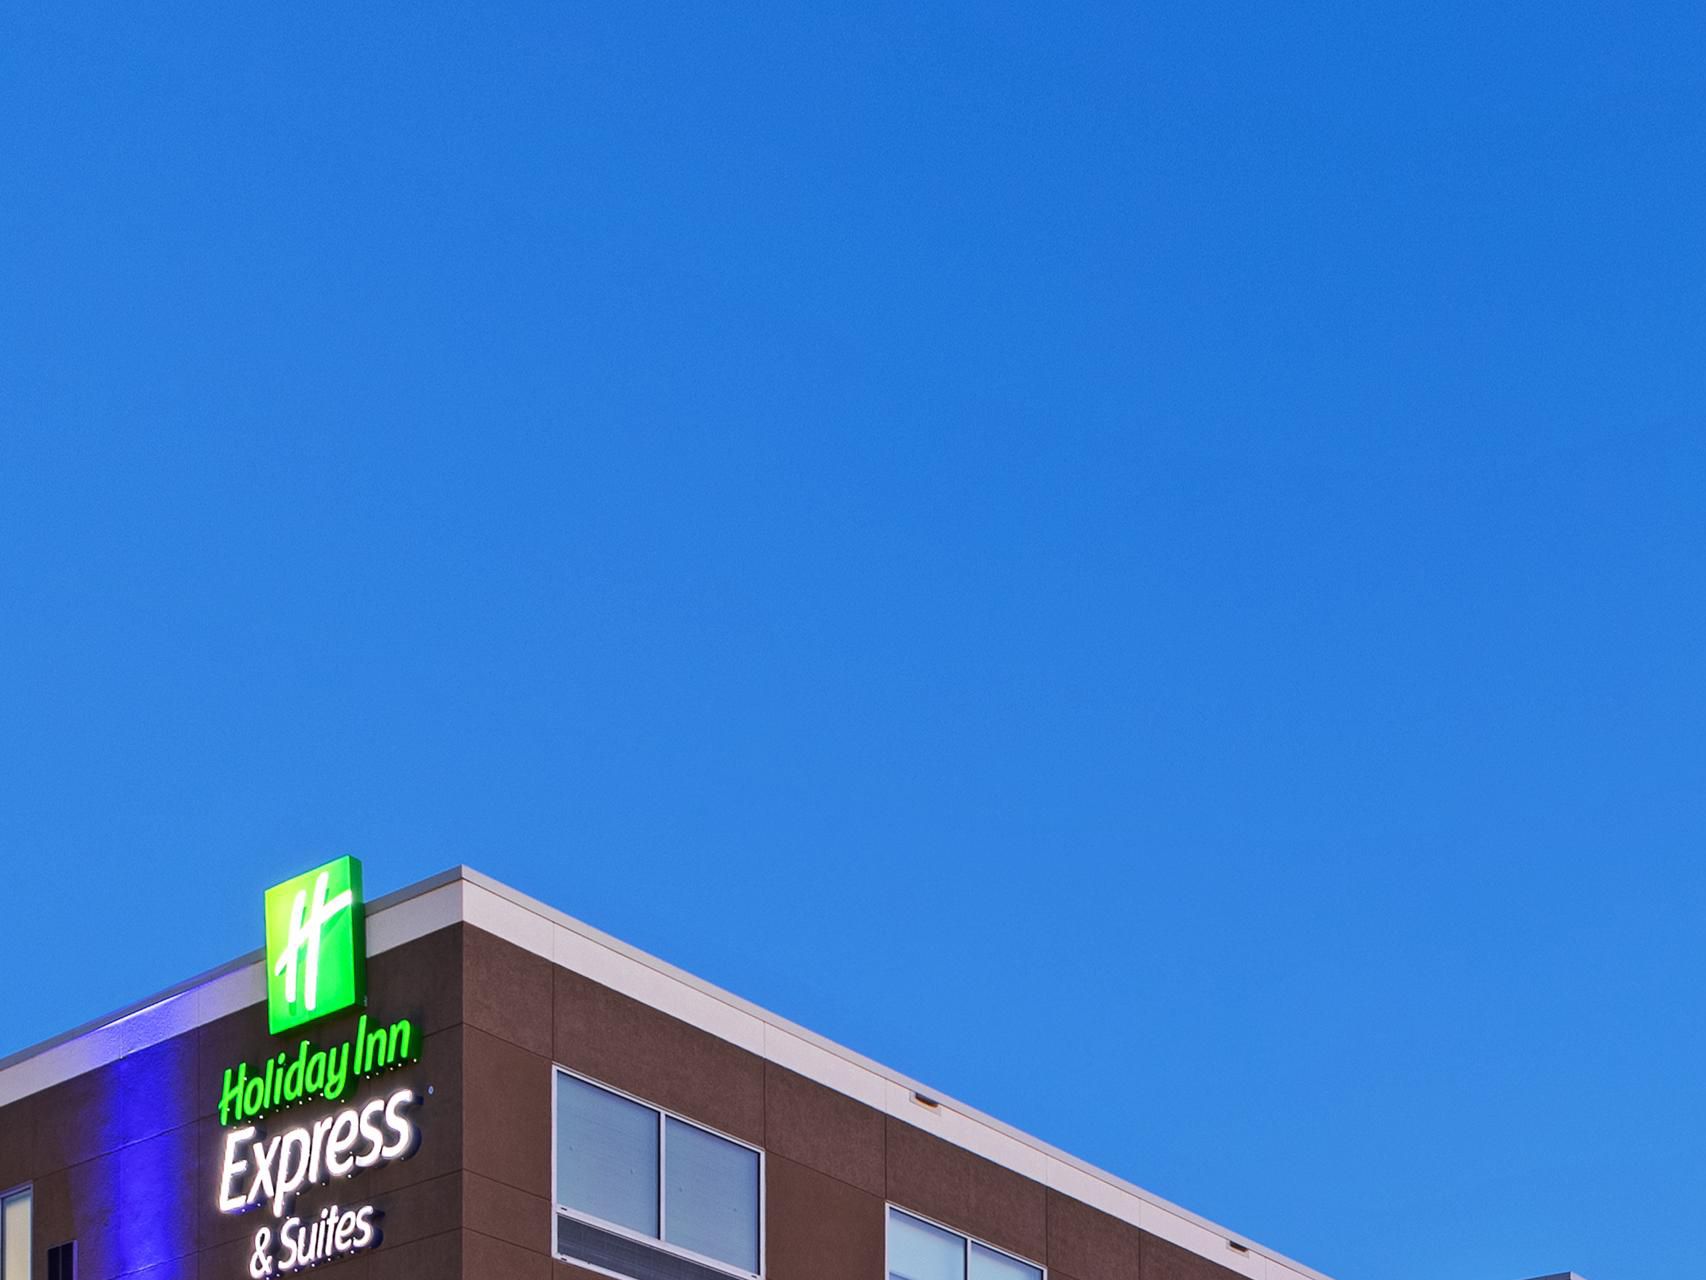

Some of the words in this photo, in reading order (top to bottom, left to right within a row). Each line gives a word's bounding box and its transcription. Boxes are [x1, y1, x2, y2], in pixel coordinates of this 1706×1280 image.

[218, 1040, 350, 1126] Holiday
[353, 1014, 411, 1075] Inn
[218, 1088, 414, 1218] Express
[249, 1226, 273, 1279] &
[277, 1204, 375, 1272] Suites
